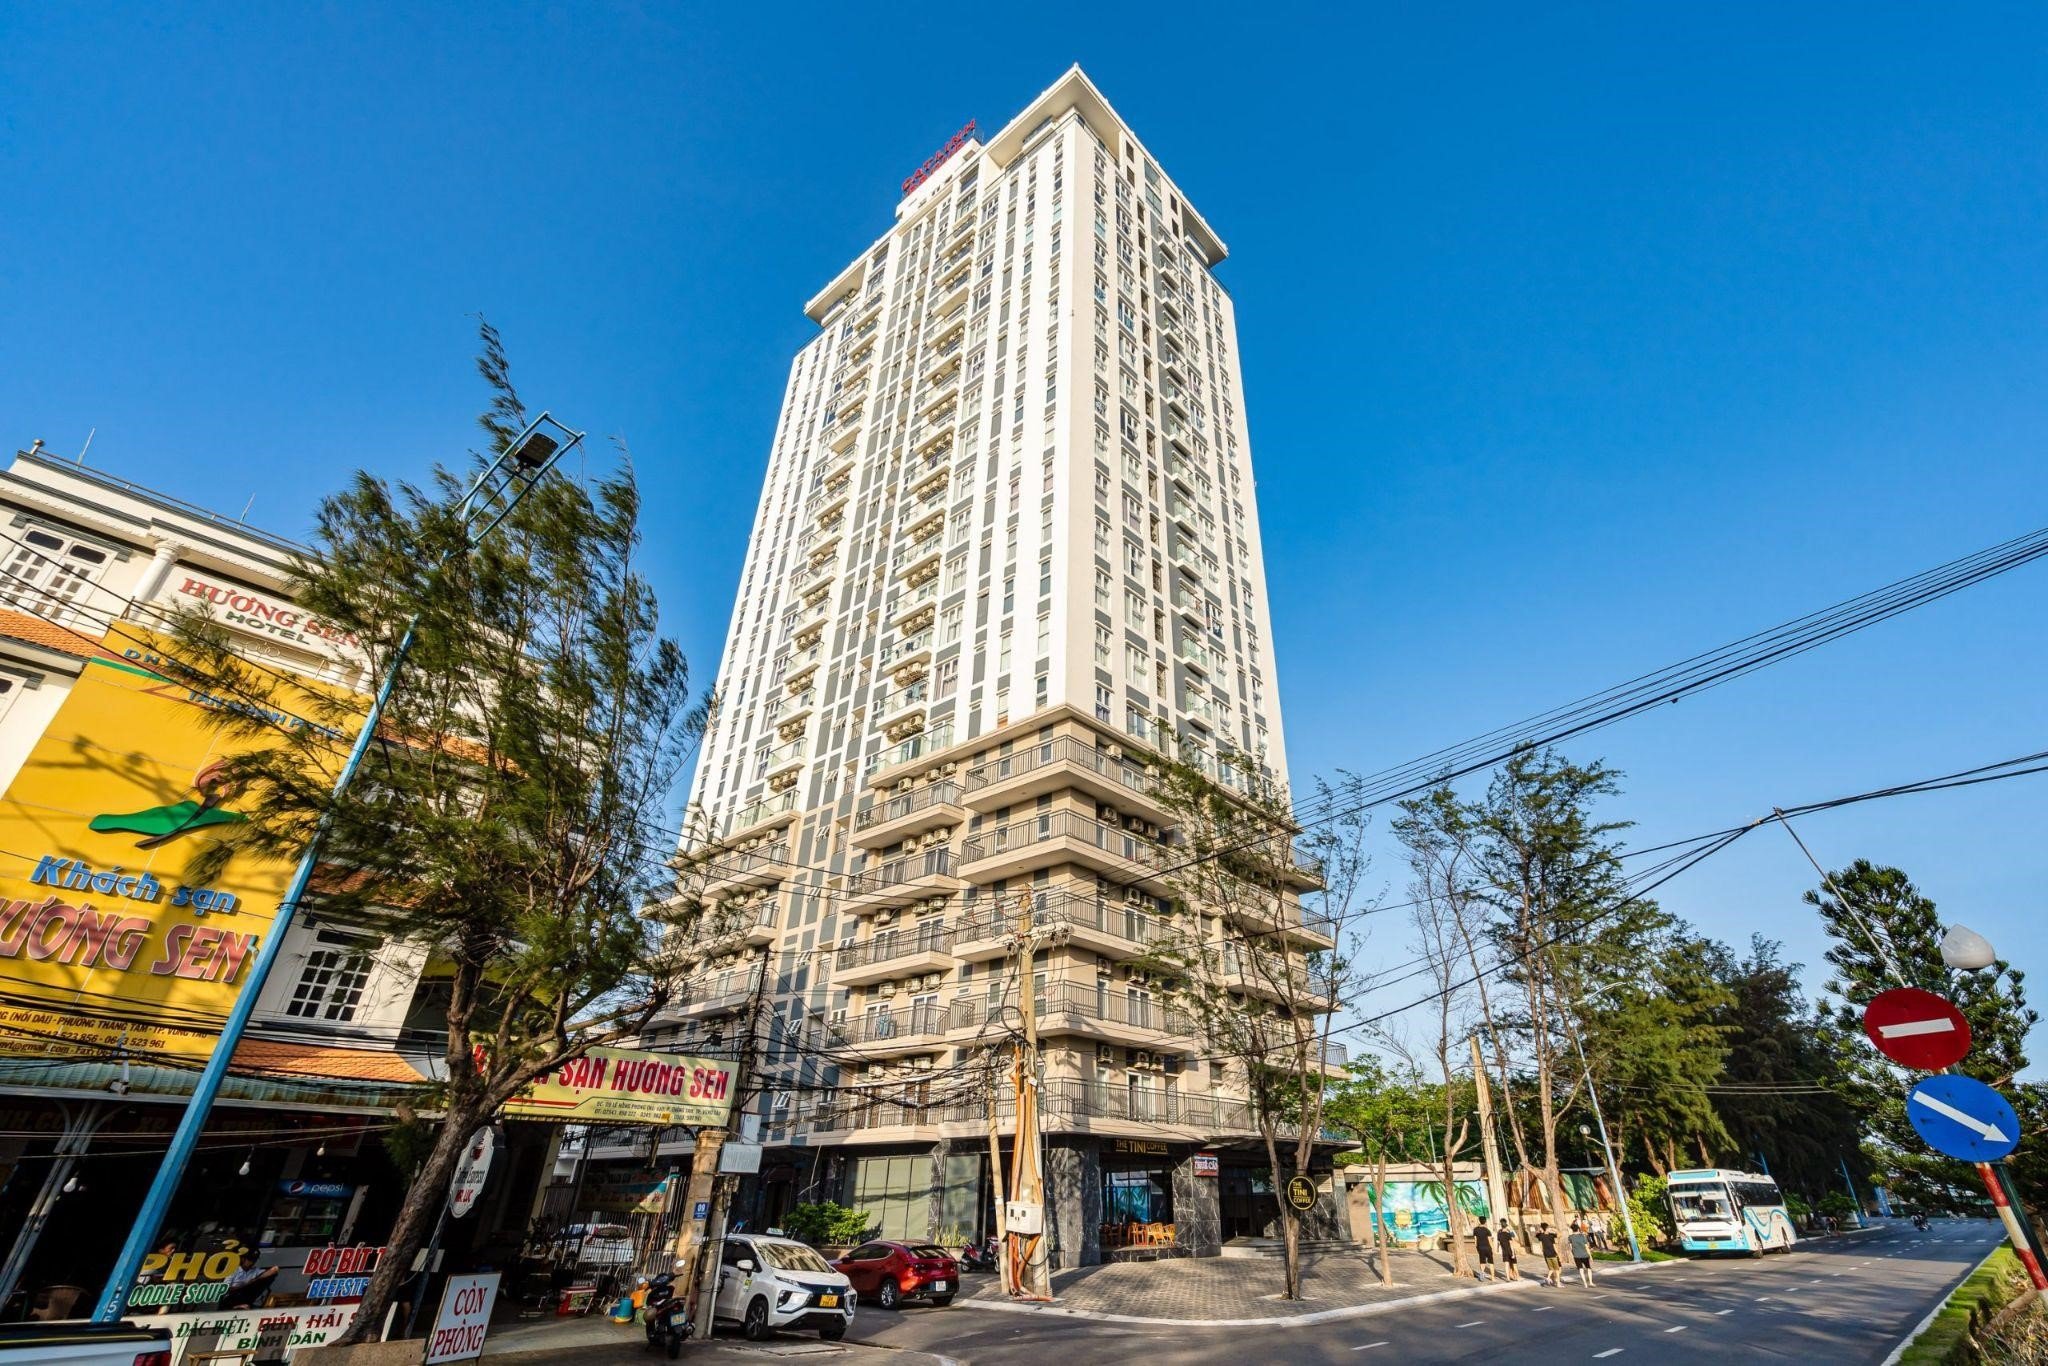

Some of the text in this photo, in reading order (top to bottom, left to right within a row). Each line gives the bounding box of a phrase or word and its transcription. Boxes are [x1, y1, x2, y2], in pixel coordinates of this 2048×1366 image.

[178, 578, 299, 628] HƯƠNG
[225, 610, 311, 646] HOTEL
[29, 855, 237, 916] Khách sạn
[0, 895, 252, 983] ƯƠNG SEN
[130, 1039, 149, 1048] 523
[149, 1040, 166, 1049] 961
[559, 1055, 730, 1100] SẠN HƯƠNG SEN
[1128, 1140, 1147, 1154] TINI
[310, 1183, 345, 1193] pepsi
[1293, 1188, 1308, 1196] TINI
[140, 1239, 249, 1281] PHỞ
[302, 1241, 337, 1275] BÒ
[334, 1241, 374, 1274] BÍT
[127, 1282, 230, 1307] OODLE SOUP
[307, 1276, 371, 1299] BEEFSTE
[453, 1279, 488, 1316] CÒN
[306, 1307, 344, 1330] HẢI
[287, 1331, 327, 1346] DÂN
[430, 1318, 485, 1358] PHÒNG
